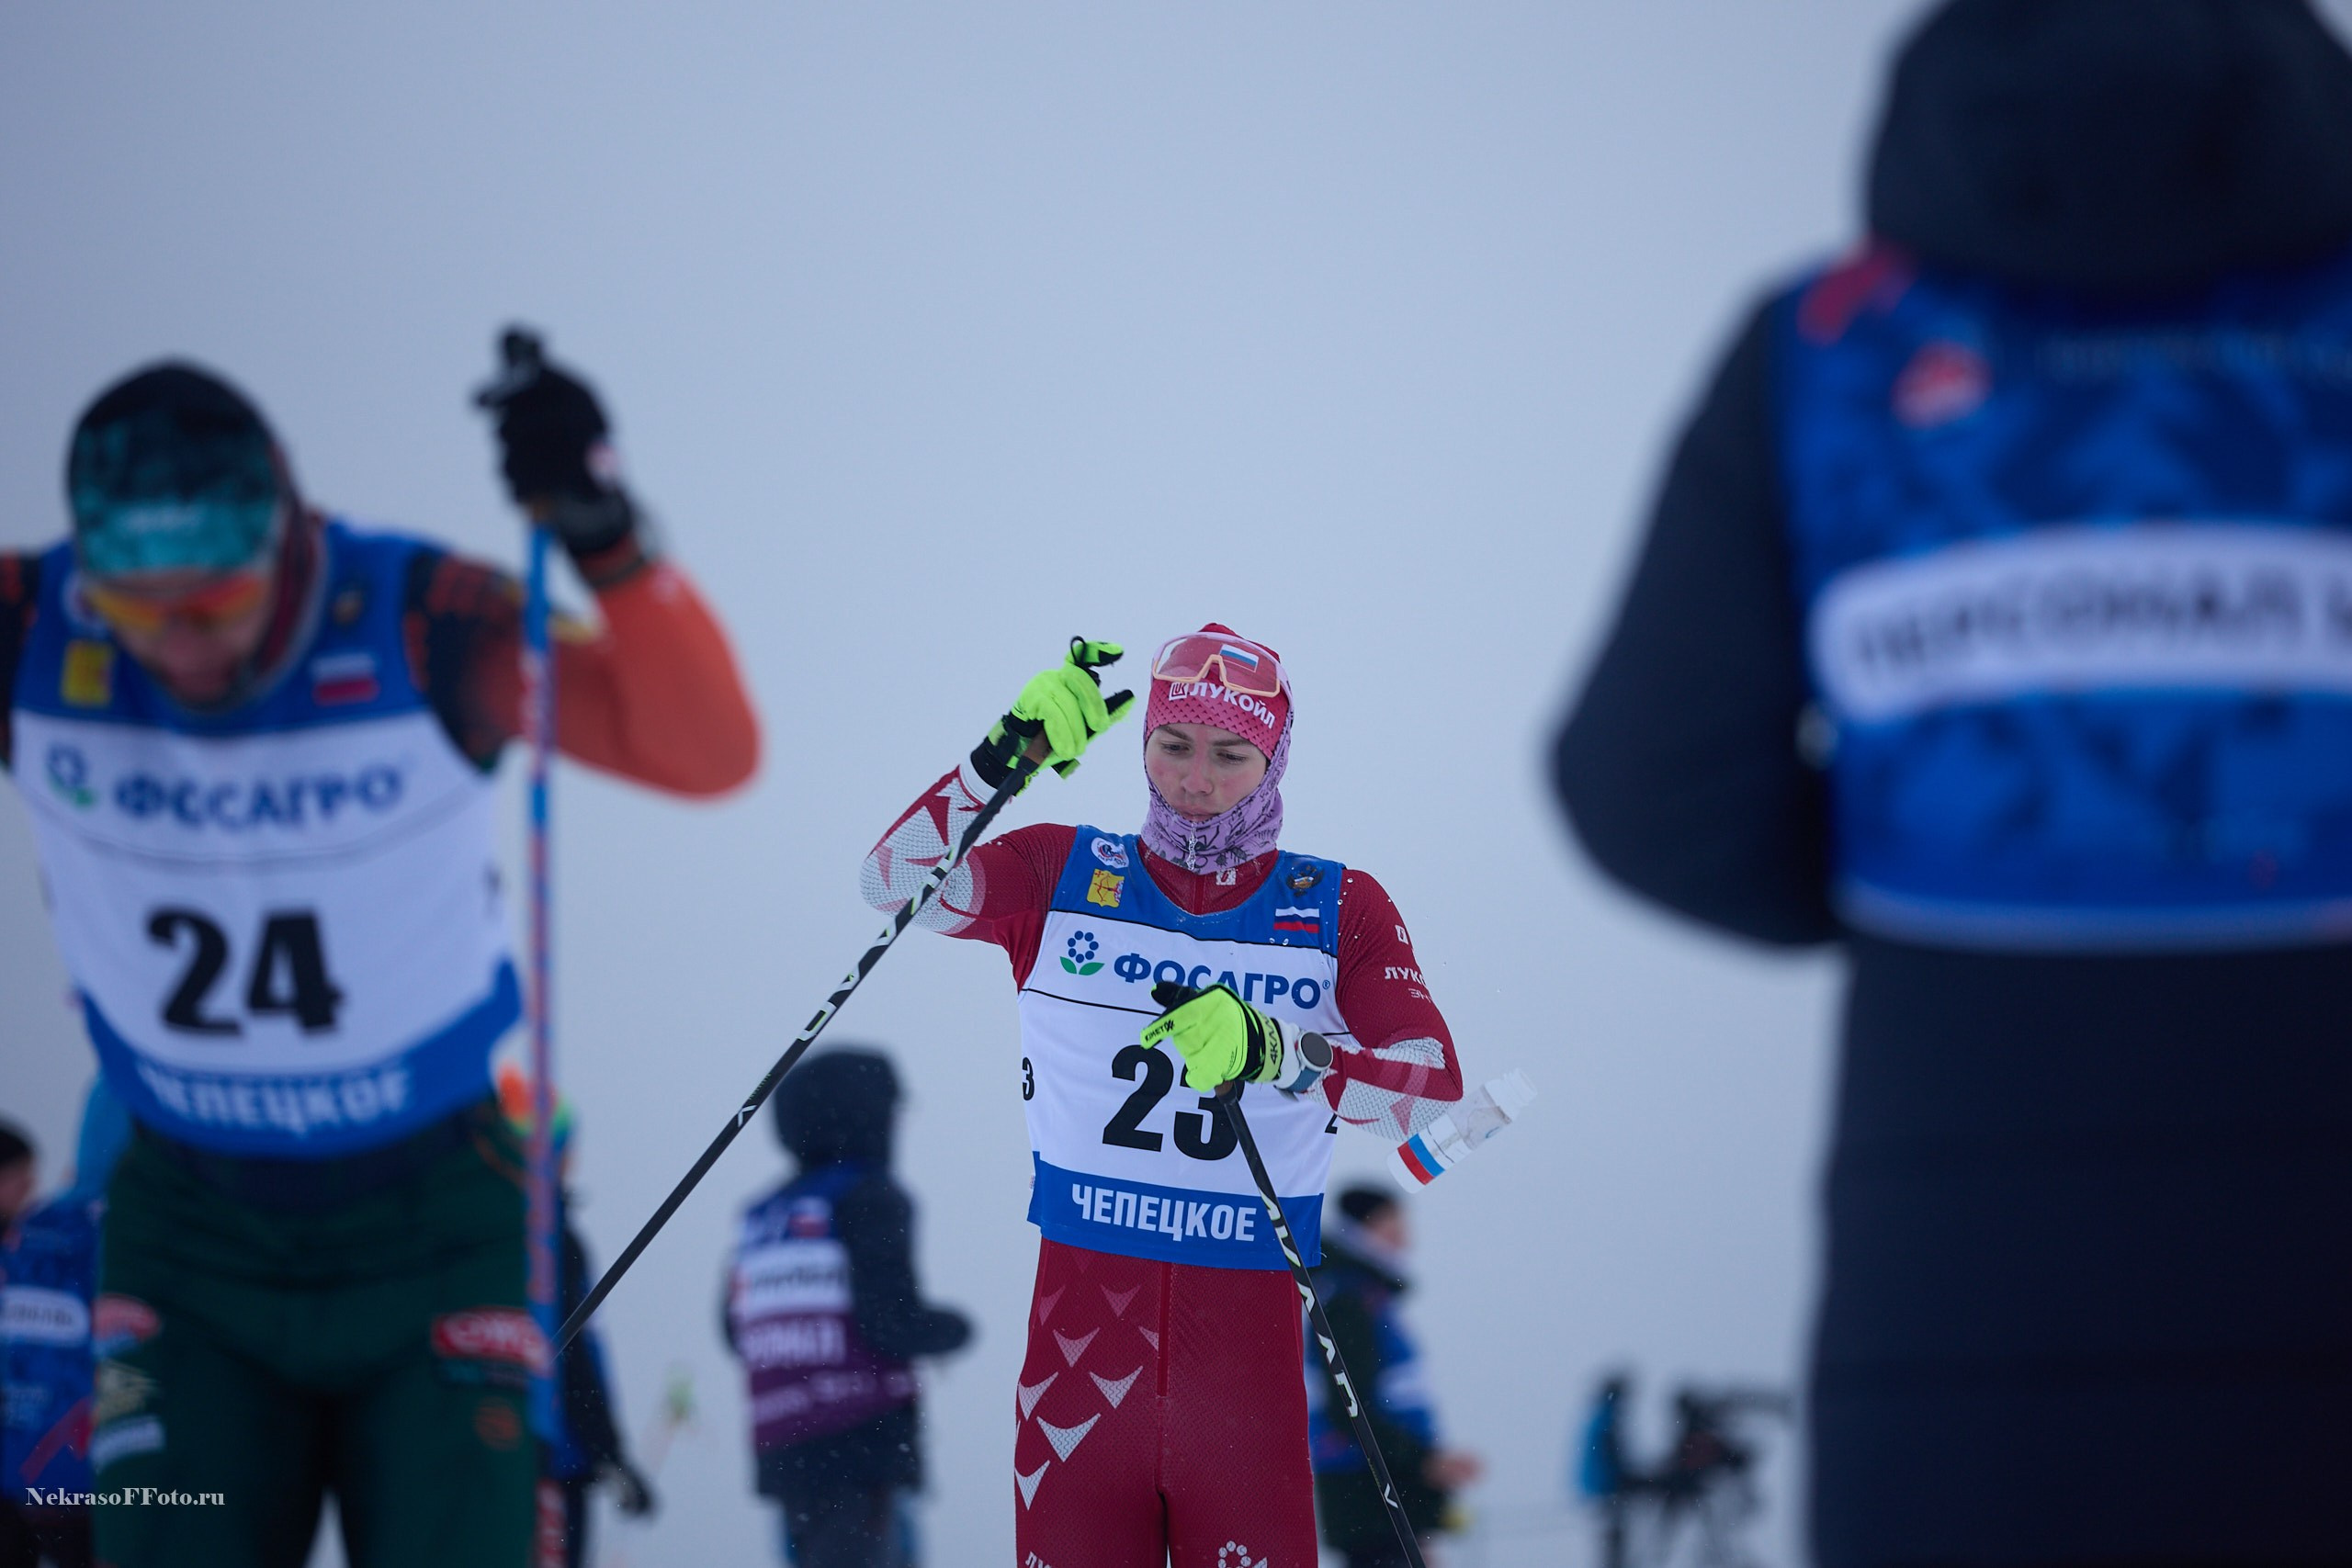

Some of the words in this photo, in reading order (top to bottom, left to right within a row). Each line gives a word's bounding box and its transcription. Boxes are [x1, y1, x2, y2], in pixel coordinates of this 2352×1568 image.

[1190, 682, 1275, 729] ЛУКОЙЛ
[145, 903, 346, 1036] 24
[1102, 1044, 1246, 1161] 23
[1071, 1183, 1257, 1242] ЧЕПЕЦКОЕ
